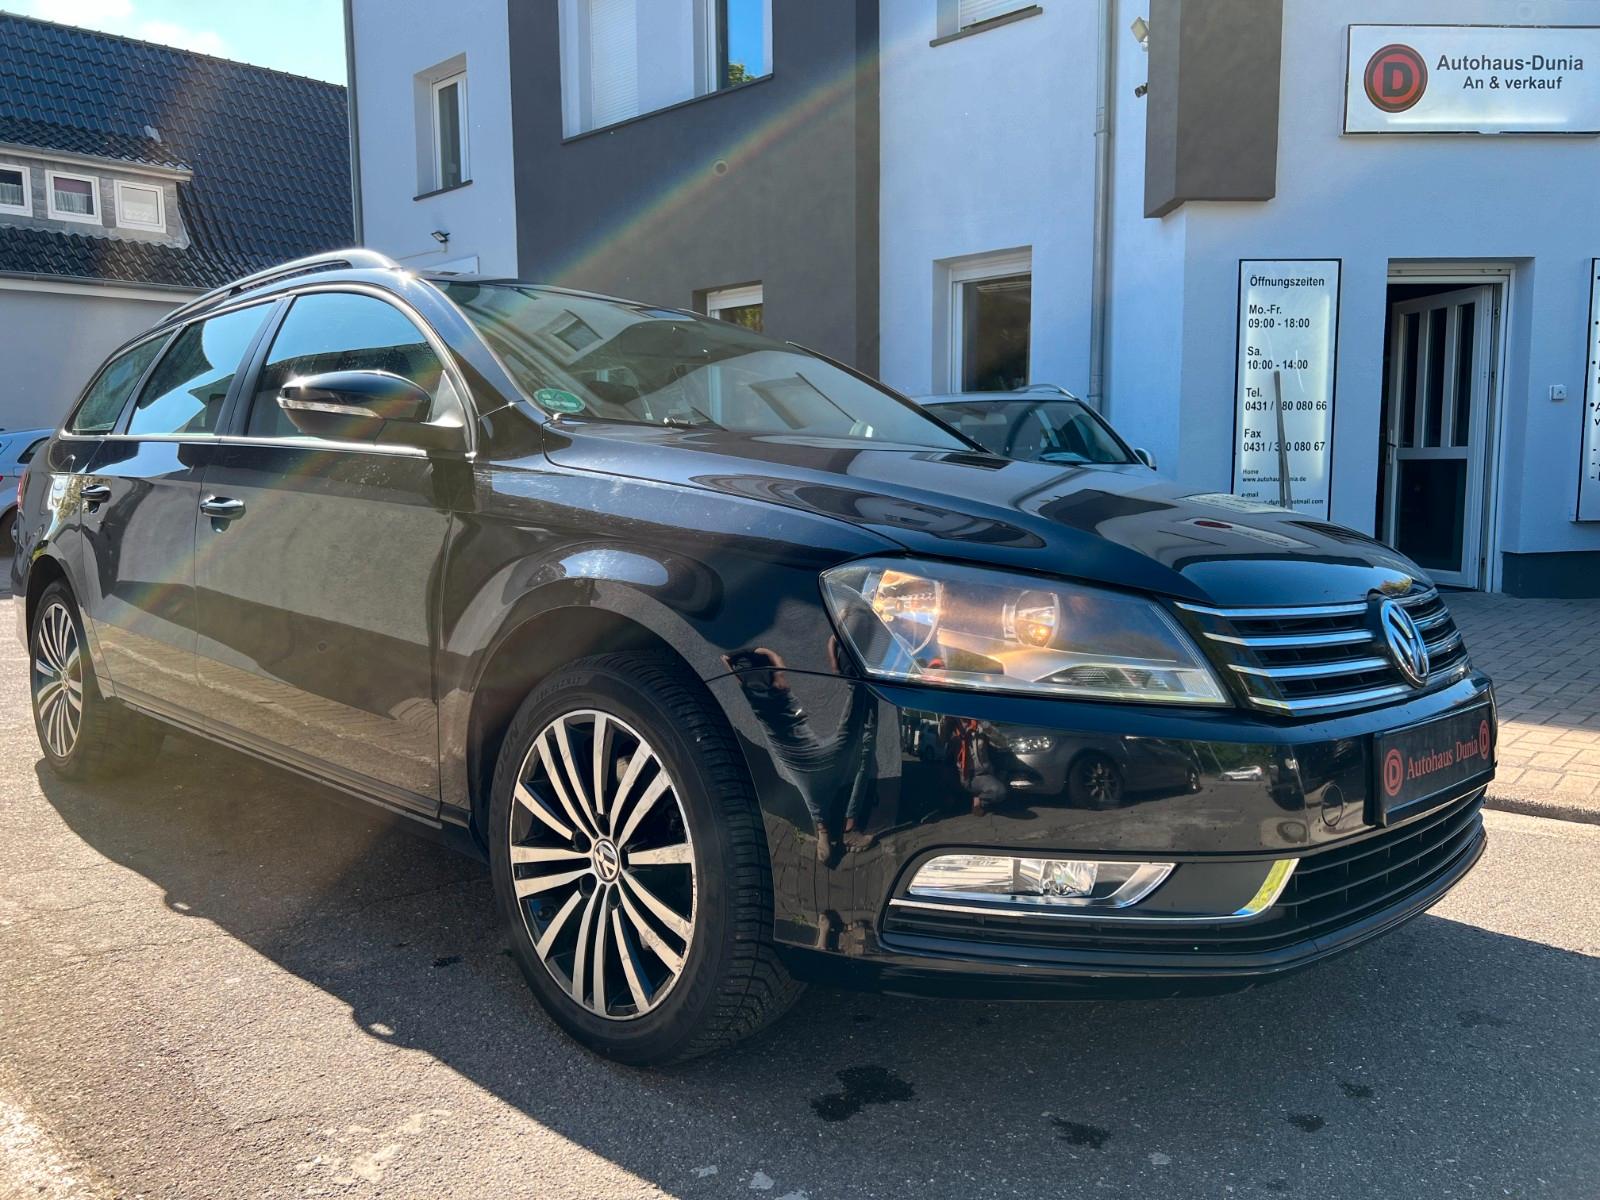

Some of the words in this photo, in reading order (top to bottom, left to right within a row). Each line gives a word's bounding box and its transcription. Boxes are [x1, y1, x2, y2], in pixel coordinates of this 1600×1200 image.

[1436, 54, 1584, 71] Autohaus-Dunia
[1462, 76, 1484, 89] An
[1489, 76, 1500, 89] &
[1505, 75, 1563, 89] verkauf
[1249, 274, 1325, 289] Öffnungszeiten
[1248, 304, 1282, 315] Mo.-Fr.
[1248, 318, 1275, 328] 09:00
[1284, 318, 1310, 328] 18:00
[1247, 346, 1262, 356] Sa.
[1247, 359, 1273, 369] 10:00
[1282, 359, 1308, 369] 14:00
[1245, 387, 1262, 398] Tel.
[1245, 401, 1267, 411] 0431
[1296, 400, 1313, 411] 080
[1315, 400, 1327, 411] 66
[1244, 428, 1262, 438] Fax
[1243, 442, 1265, 452] 0431
[1274, 441, 1291, 452] 30
[1294, 441, 1311, 452] 080
[1313, 441, 1325, 452] 67
[1407, 748, 1454, 780] Autohaus
[1455, 736, 1478, 763] Dunia
